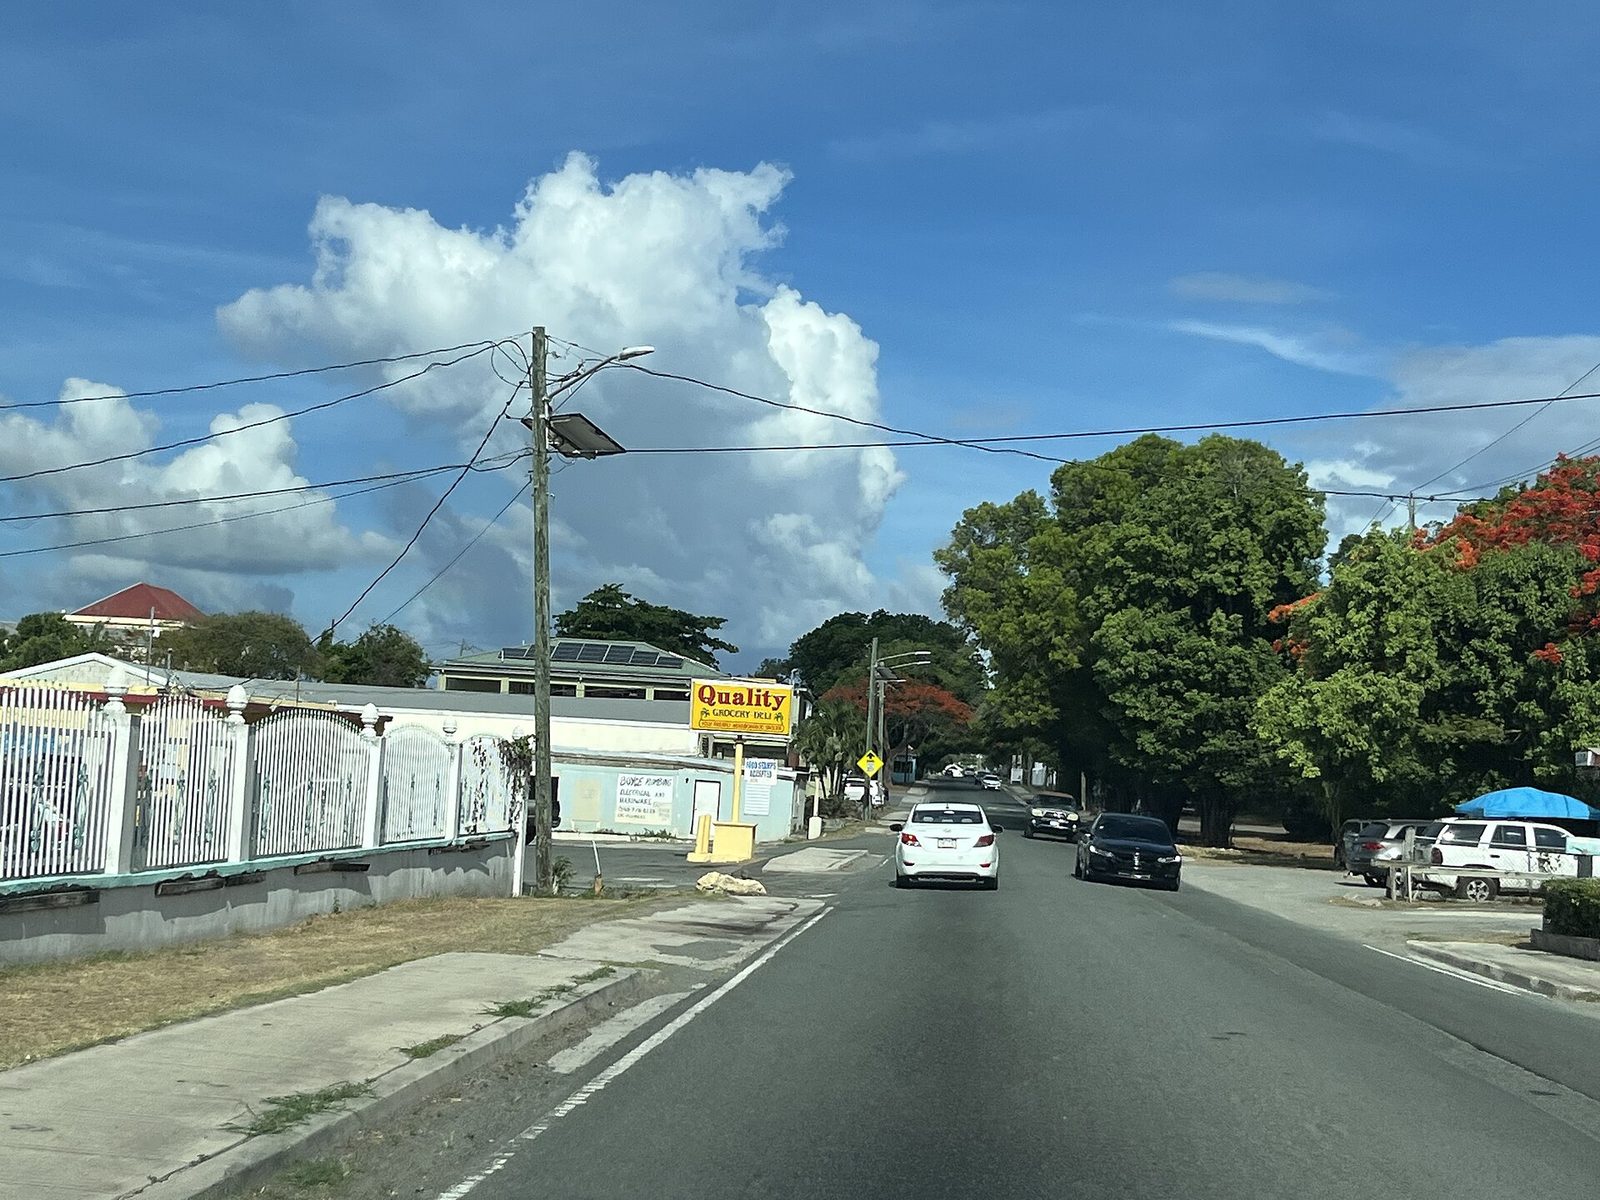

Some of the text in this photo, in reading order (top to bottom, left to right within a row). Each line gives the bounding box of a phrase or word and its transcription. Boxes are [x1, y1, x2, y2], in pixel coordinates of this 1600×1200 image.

[698, 685, 787, 711] Quality
[712, 708, 772, 720] GROCERY DELI
[746, 761, 757, 769] FOOD
